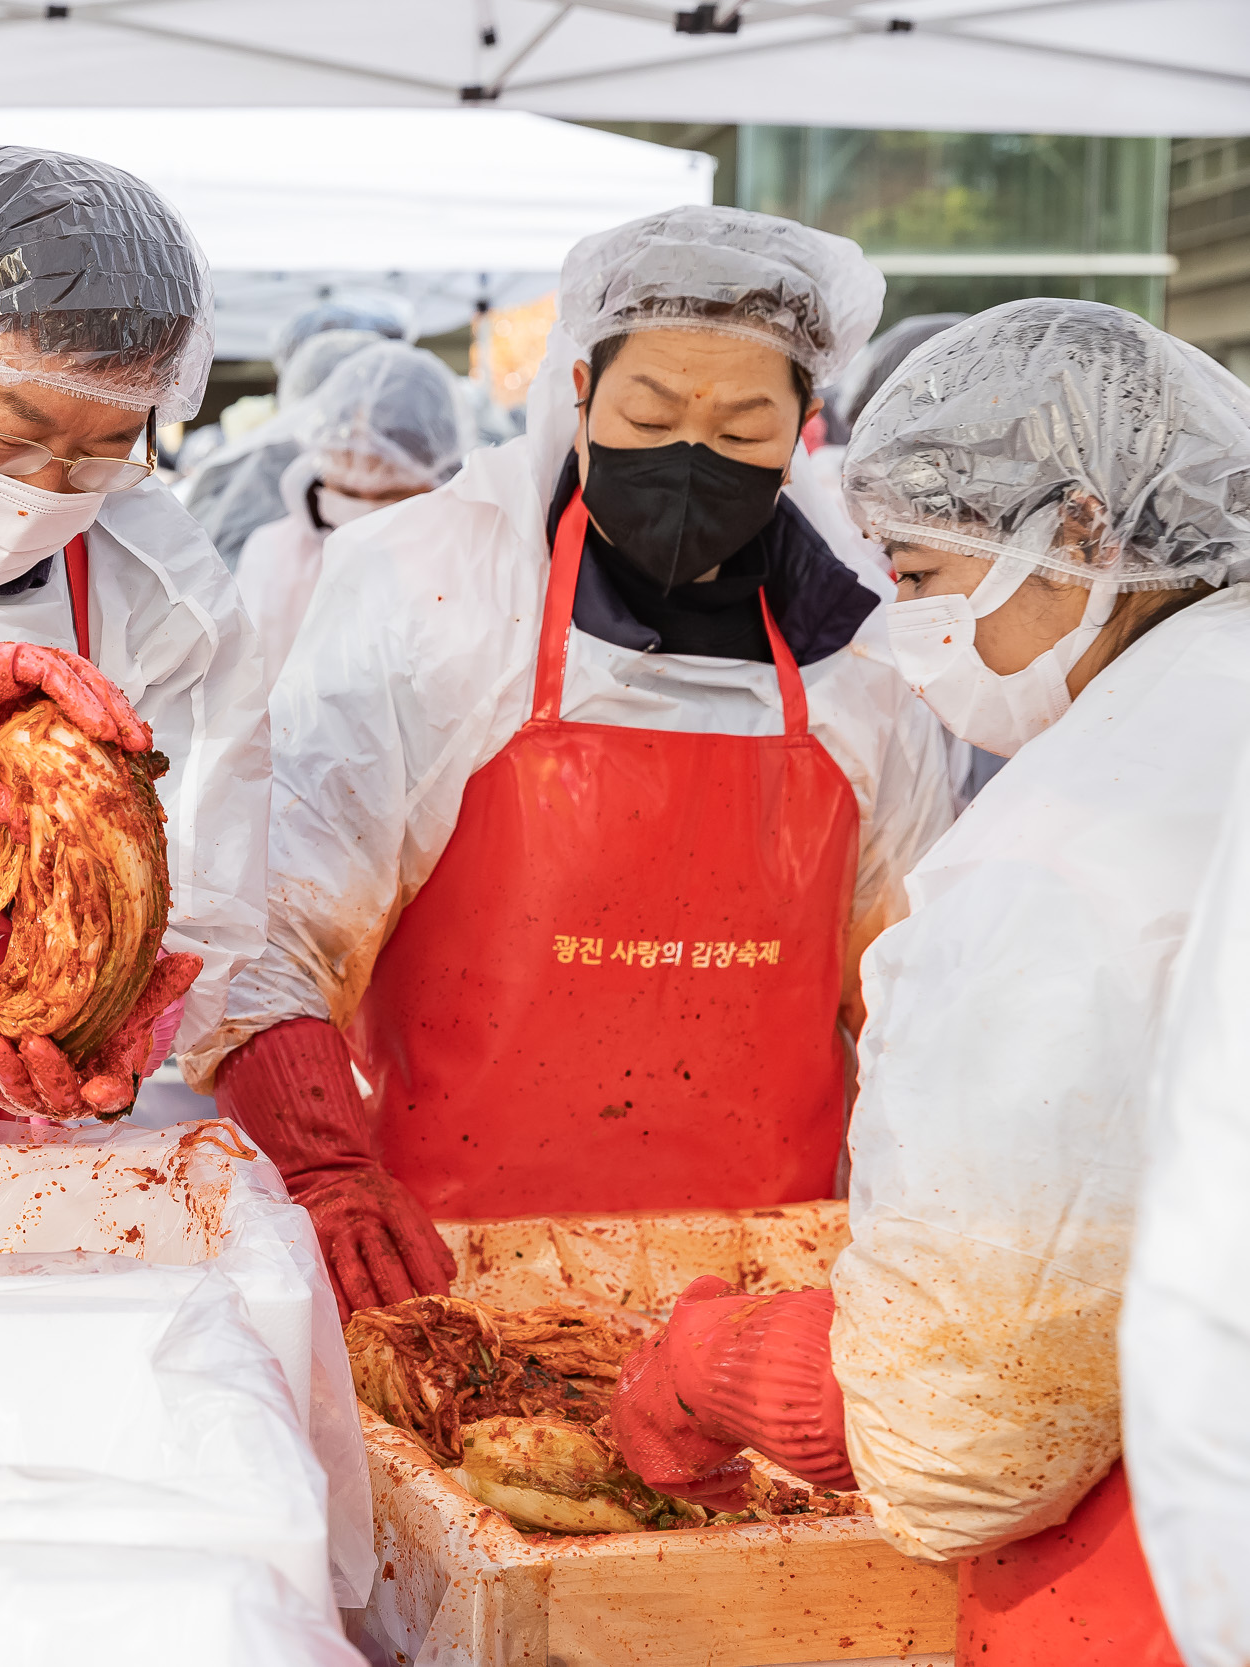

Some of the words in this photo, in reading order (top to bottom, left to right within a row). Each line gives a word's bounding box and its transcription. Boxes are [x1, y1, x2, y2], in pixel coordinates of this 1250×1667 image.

[552, 934, 604, 965] 광진
[609, 940, 684, 969] 사랑의
[690, 939, 781, 969] 김장축제
